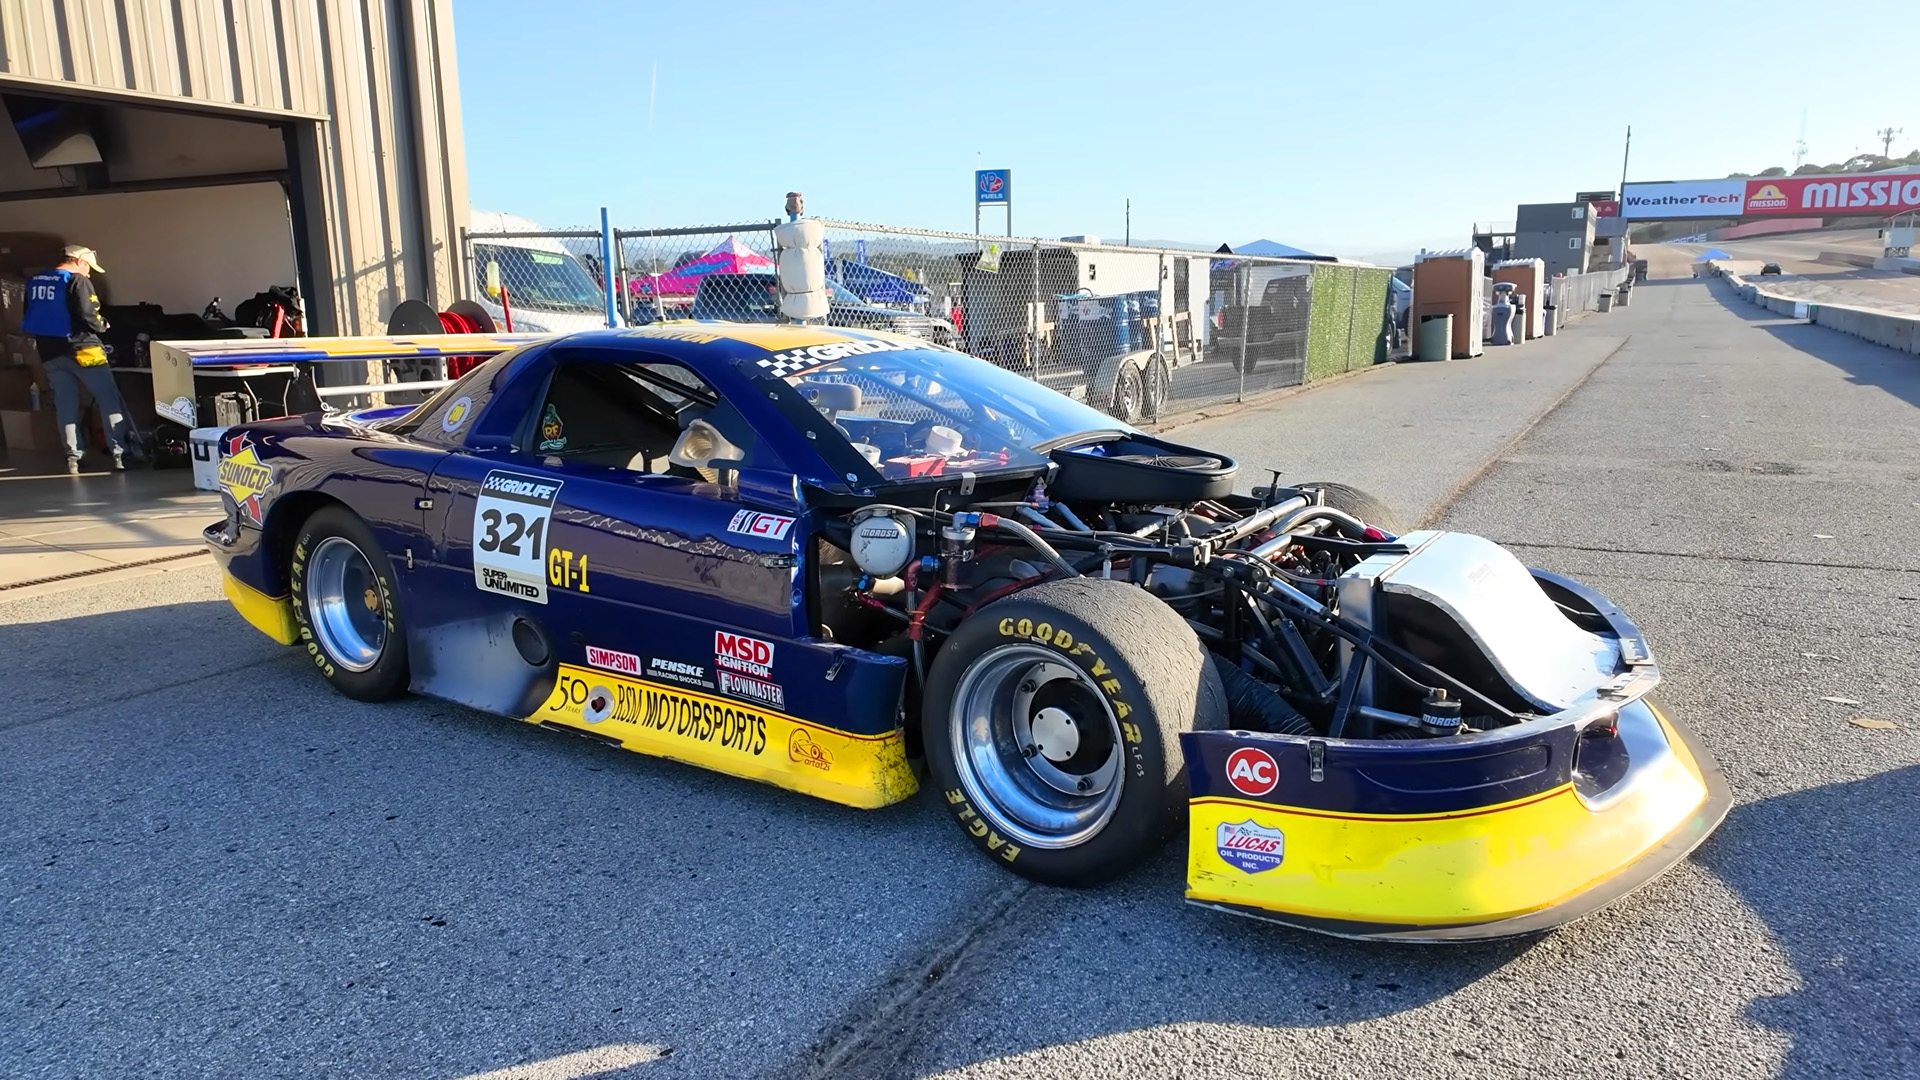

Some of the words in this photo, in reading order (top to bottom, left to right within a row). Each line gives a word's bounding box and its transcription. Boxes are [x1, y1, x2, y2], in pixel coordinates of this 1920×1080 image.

[1626, 194, 1739, 206] WeatherTech
[32, 286, 55, 300] 106
[807, 339, 950, 361] GRIDL
[220, 461, 269, 491] SUNOCO
[501, 480, 557, 499] GRIDLIFE
[479, 509, 545, 560] 321
[752, 515, 792, 535] GT
[861, 529, 898, 538] MOROSO
[483, 568, 508, 580] SUPER
[549, 548, 589, 592] GT-1
[485, 577, 539, 598] UNLIMITED
[291, 543, 334, 677] GOODYEAR
[378, 577, 394, 633] EAGLE
[717, 633, 770, 665] MSD
[590, 649, 637, 673] SIMPSON
[651, 658, 704, 677] PENSKE
[718, 655, 769, 678] IGNITION
[657, 671, 678, 681] RACING
[679, 675, 702, 686] SHOCKS
[721, 673, 782, 704] FLOWMASTER
[999, 618, 1142, 744] GOODYEAR
[550, 676, 588, 711] 50
[564, 705, 581, 714] YEARS
[612, 684, 642, 725] RSM
[642, 690, 766, 755] MOTORSPORTS
[1231, 758, 1271, 783] AC
[945, 788, 1021, 862] EAGLE
[1225, 835, 1280, 852] LUCAS
[1236, 852, 1280, 864] PRODUCTS
[1242, 861, 1259, 870] INC.
